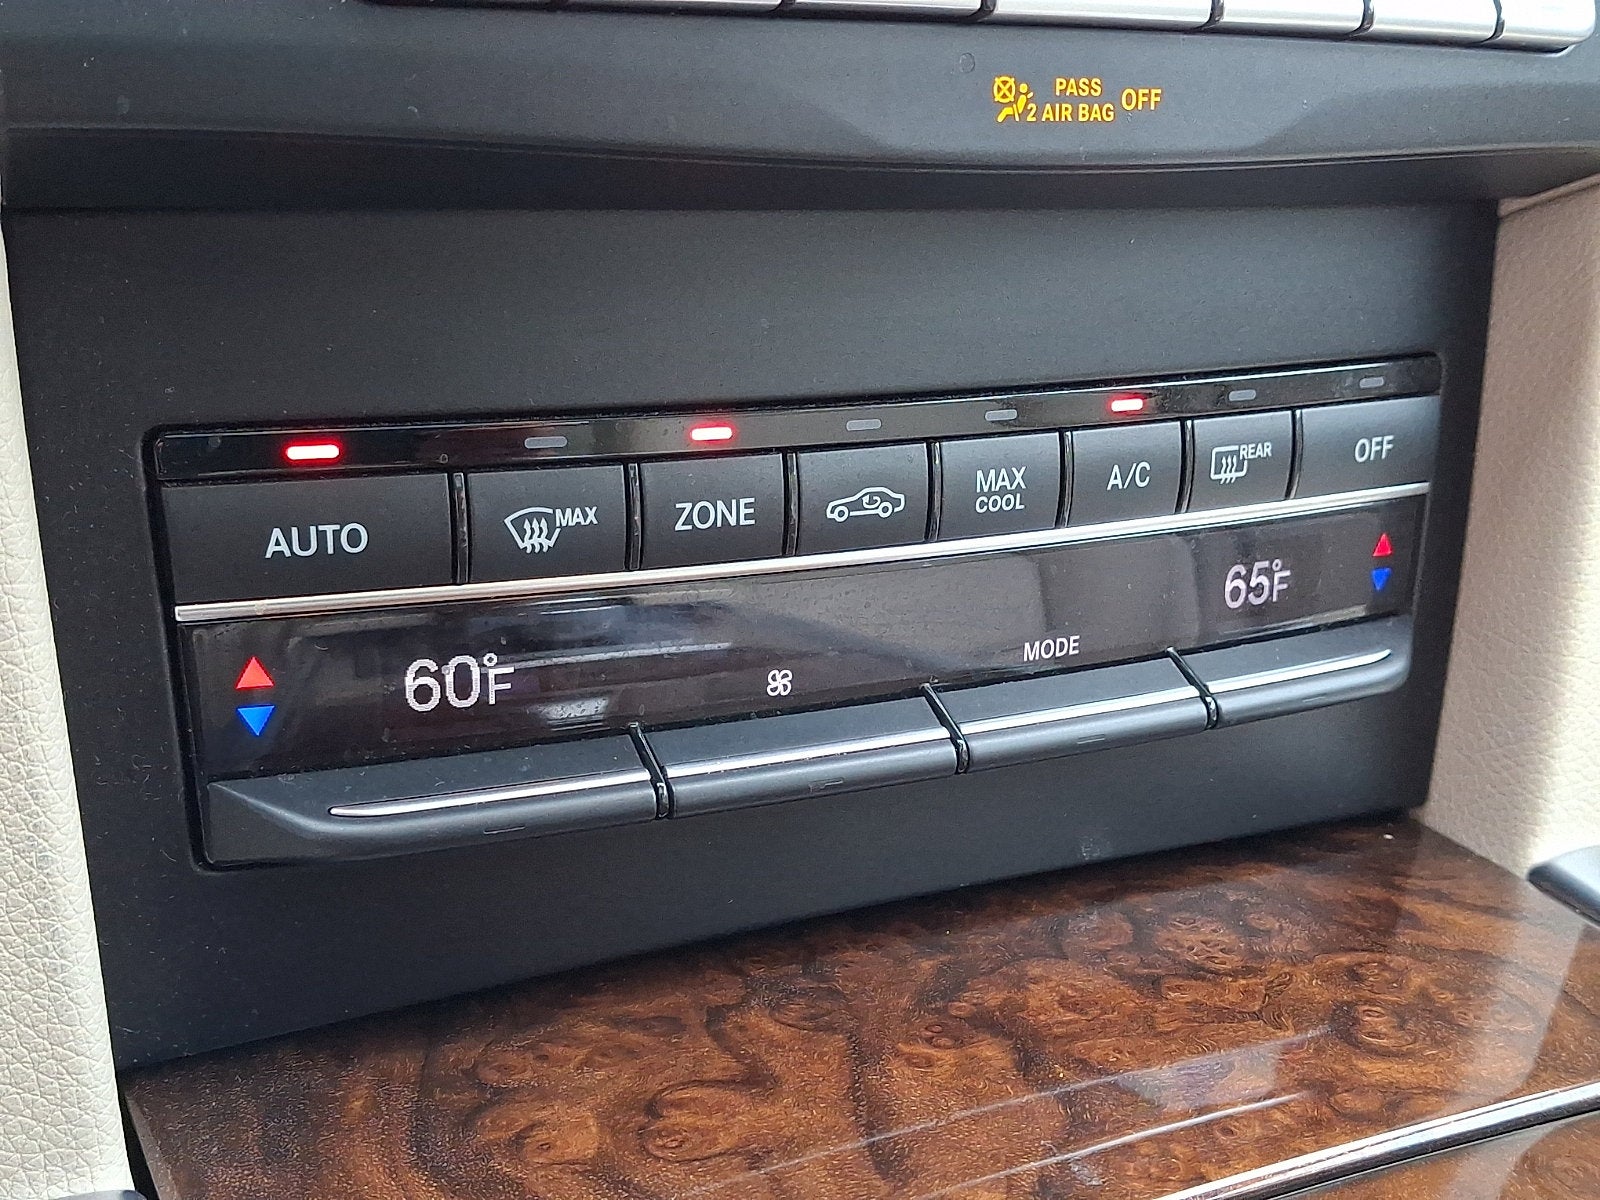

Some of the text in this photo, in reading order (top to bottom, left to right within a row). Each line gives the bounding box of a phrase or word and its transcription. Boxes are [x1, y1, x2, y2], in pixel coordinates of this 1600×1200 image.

[1055, 77, 1102, 97] PASS
[1121, 88, 1162, 111] OFF
[1026, 102, 1115, 122] 2 AIR BAG
[1239, 441, 1272, 461] REAR
[1354, 435, 1394, 464] OFF
[975, 466, 1026, 493] MAX
[1107, 461, 1151, 491] A/C
[674, 497, 756, 532] ZONE
[975, 492, 1025, 513] COOL
[555, 506, 598, 528] MAX
[265, 522, 368, 559] AUTO
[1023, 635, 1081, 662] MODE
